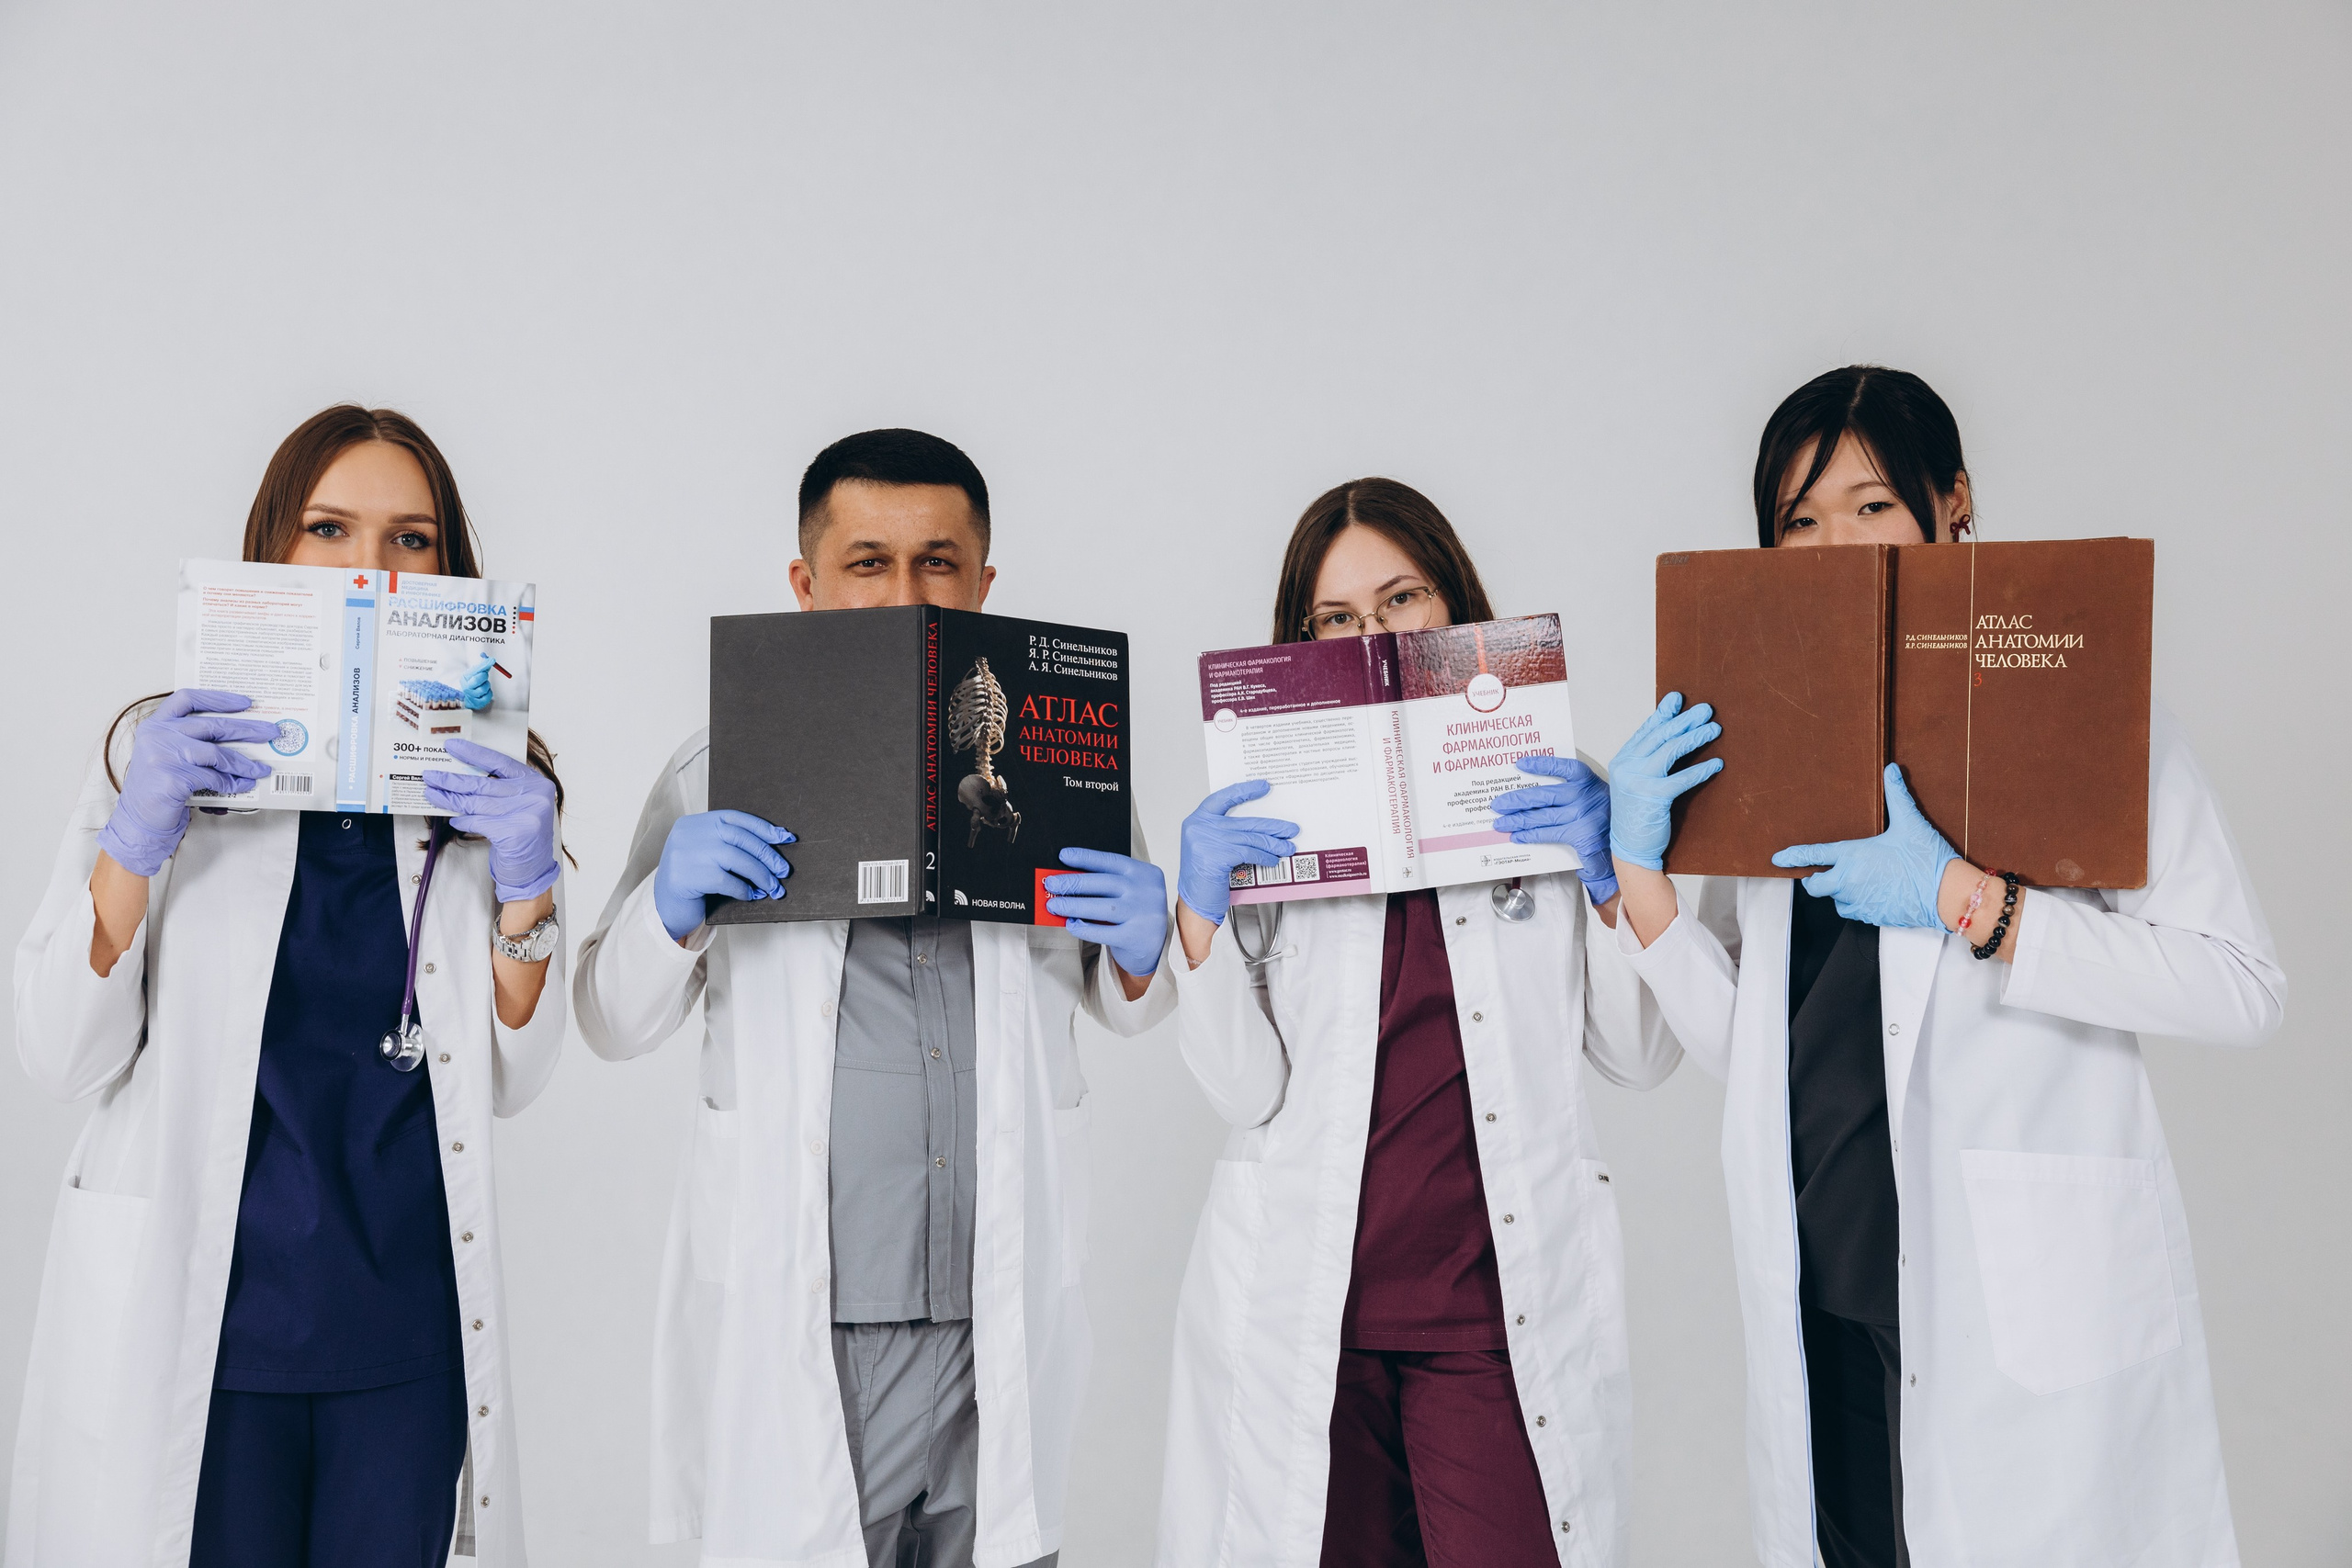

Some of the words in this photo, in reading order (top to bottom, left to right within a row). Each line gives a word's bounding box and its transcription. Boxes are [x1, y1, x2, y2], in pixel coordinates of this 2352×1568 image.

[389, 596, 507, 615] РАСШИФРОВКА
[387, 610, 507, 633] АНАЛИЗОВ
[1975, 615, 2033, 629] АТЛАС
[386, 630, 447, 640] ЛАБОРАТОРНАЯ
[449, 634, 505, 644] ДИАГНОСТИКА
[1029, 635, 1036, 646] Р.
[1039, 637, 1050, 649] Д.
[1052, 638, 1117, 656] Синельников
[1974, 634, 2084, 649] АНАТОМИИ
[928, 622, 938, 696] ЧЕЛОВЕКА
[1029, 649, 1039, 659] Я.
[1042, 649, 1050, 660] Р.
[1052, 651, 1117, 669] Синельников
[1208, 660, 1247, 670] КЛИНИЧЕСКАЯ
[1248, 656, 1292, 665] ФАРМАКОЛОГИЯ
[1975, 654, 2067, 668] ЧЕЛОВЕКА
[1029, 661, 1038, 671] А.
[1041, 662, 1051, 672] Я.
[1054, 663, 1118, 681] Синельников
[1214, 668, 1263, 678] ФАРМАКОТЕРАПИЯ
[1974, 672, 1983, 686] 3
[352, 667, 361, 714] АНАЛИЗОВ
[1019, 694, 1118, 728] АТЛАС
[1446, 715, 1532, 736] КЛИНИЧЕСКАЯ
[393, 742, 422, 752] 300+
[927, 700, 937, 783] АНАТОМИИ
[1019, 726, 1118, 749] АНАТОМИИ
[1442, 731, 1541, 754] ФАРМАКОЛОГИЯ
[349, 716, 358, 784] РАСШИФРОВКА
[1020, 745, 1118, 770] ЧЕЛОВЕКА
[1433, 761, 1442, 773] И
[1063, 776, 1082, 788] Том
[1085, 781, 1119, 792] второй
[1392, 711, 1406, 779] КЛИНИЧЕСКАЯ
[1399, 781, 1415, 859] ФАРМАКОЛОГИЯ
[1487, 774, 1521, 785] редакцией
[1384, 747, 1401, 834] ФАРМАКОТЕРАПИЯ
[1454, 787, 1488, 797] академика
[926, 785, 936, 831] АТЛАС
[1447, 797, 1487, 807] профессора
[926, 852, 935, 870] 2
[972, 898, 998, 908] НОВАЯ
[1000, 900, 1025, 909] ВОЛНА
